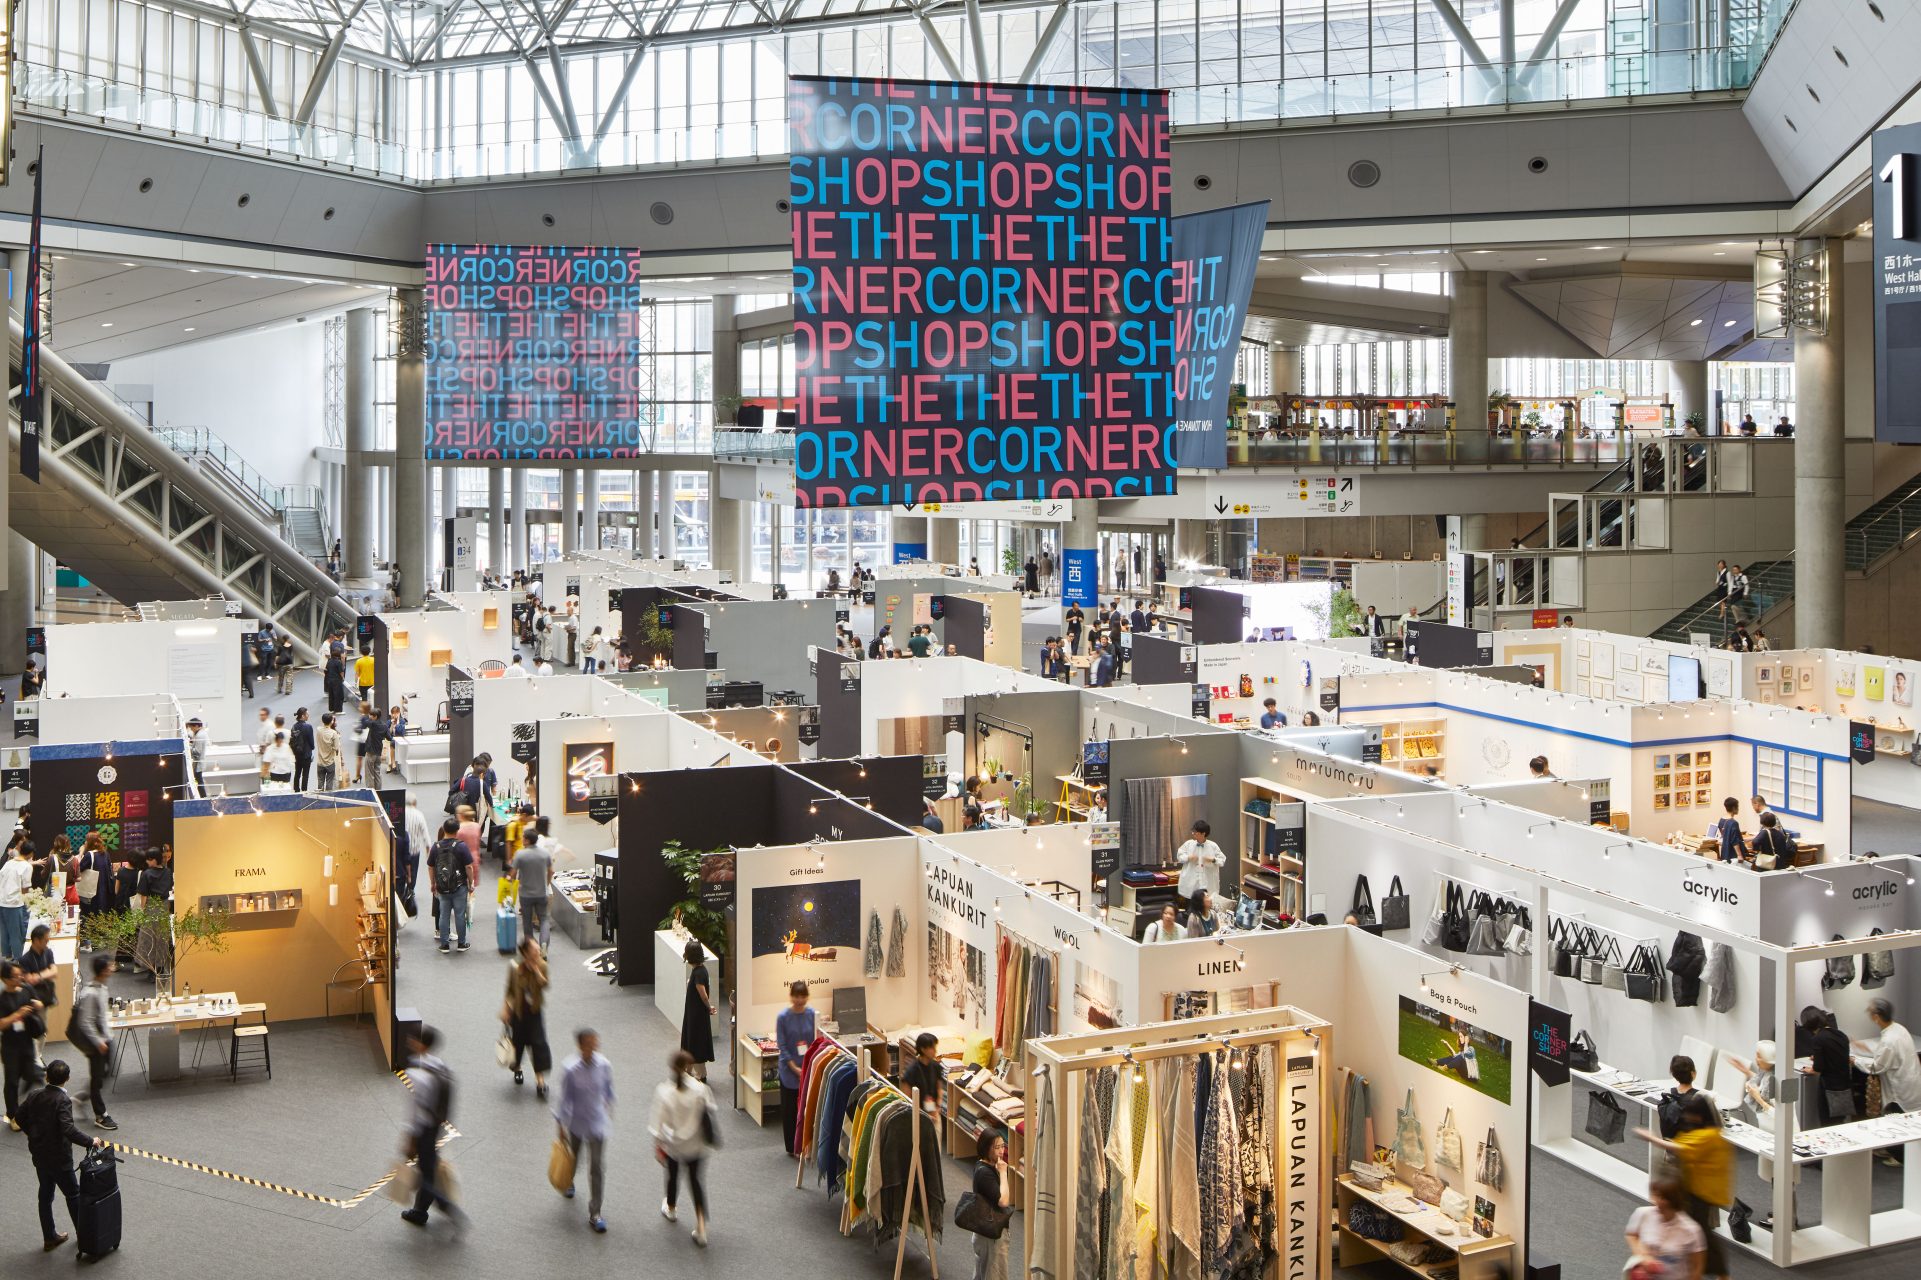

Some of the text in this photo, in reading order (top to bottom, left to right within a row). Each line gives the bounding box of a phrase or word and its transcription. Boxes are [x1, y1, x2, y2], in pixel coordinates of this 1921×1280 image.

[791, 156, 1172, 211] SHOPSHOPSHOP
[1884, 272, 1905, 285] West
[1068, 566, 1082, 582] 西
[831, 825, 844, 841] MY
[234, 867, 267, 878] FRAMA
[789, 867, 824, 876] Gift Ideas
[1683, 880, 1739, 906] acrylic
[1852, 880, 1898, 900] acrylic
[928, 883, 987, 929] KANKURIT
[1198, 959, 1243, 976] LINEN
[807, 977, 830, 987] joulua
[1430, 988, 1477, 1015] Bag & Pouch
[1542, 1023, 1559, 1036] THE
[1533, 1030, 1567, 1051] CORNER
[1538, 1041, 1562, 1057] SHOP
[1290, 1085, 1306, 1188] LAPUAN
